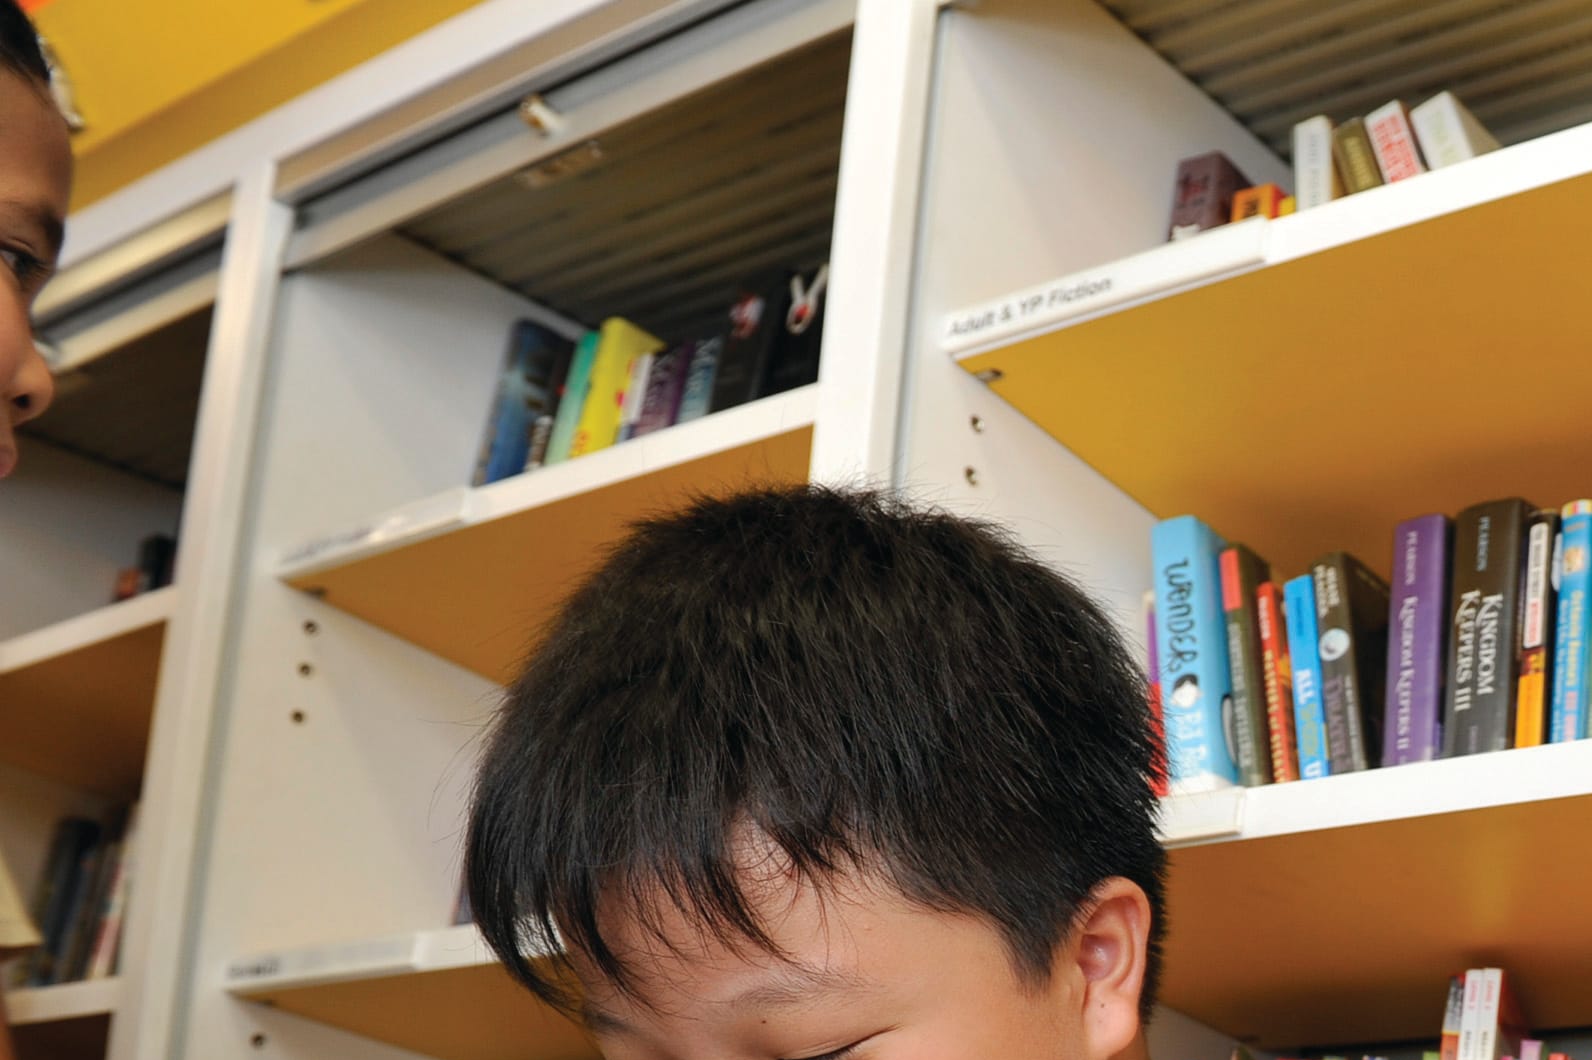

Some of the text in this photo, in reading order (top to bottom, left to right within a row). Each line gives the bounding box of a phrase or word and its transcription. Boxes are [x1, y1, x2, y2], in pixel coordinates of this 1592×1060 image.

[950, 277, 1113, 336] Adult & YP Fiction
[1404, 530, 1418, 585] PEARSON
[1394, 596, 1419, 750] KINGDOM KEEPERS II
[1453, 589, 1481, 712] KEEPERS III
[1476, 592, 1505, 696] KINGDOM
[1295, 669, 1315, 706] ALL
